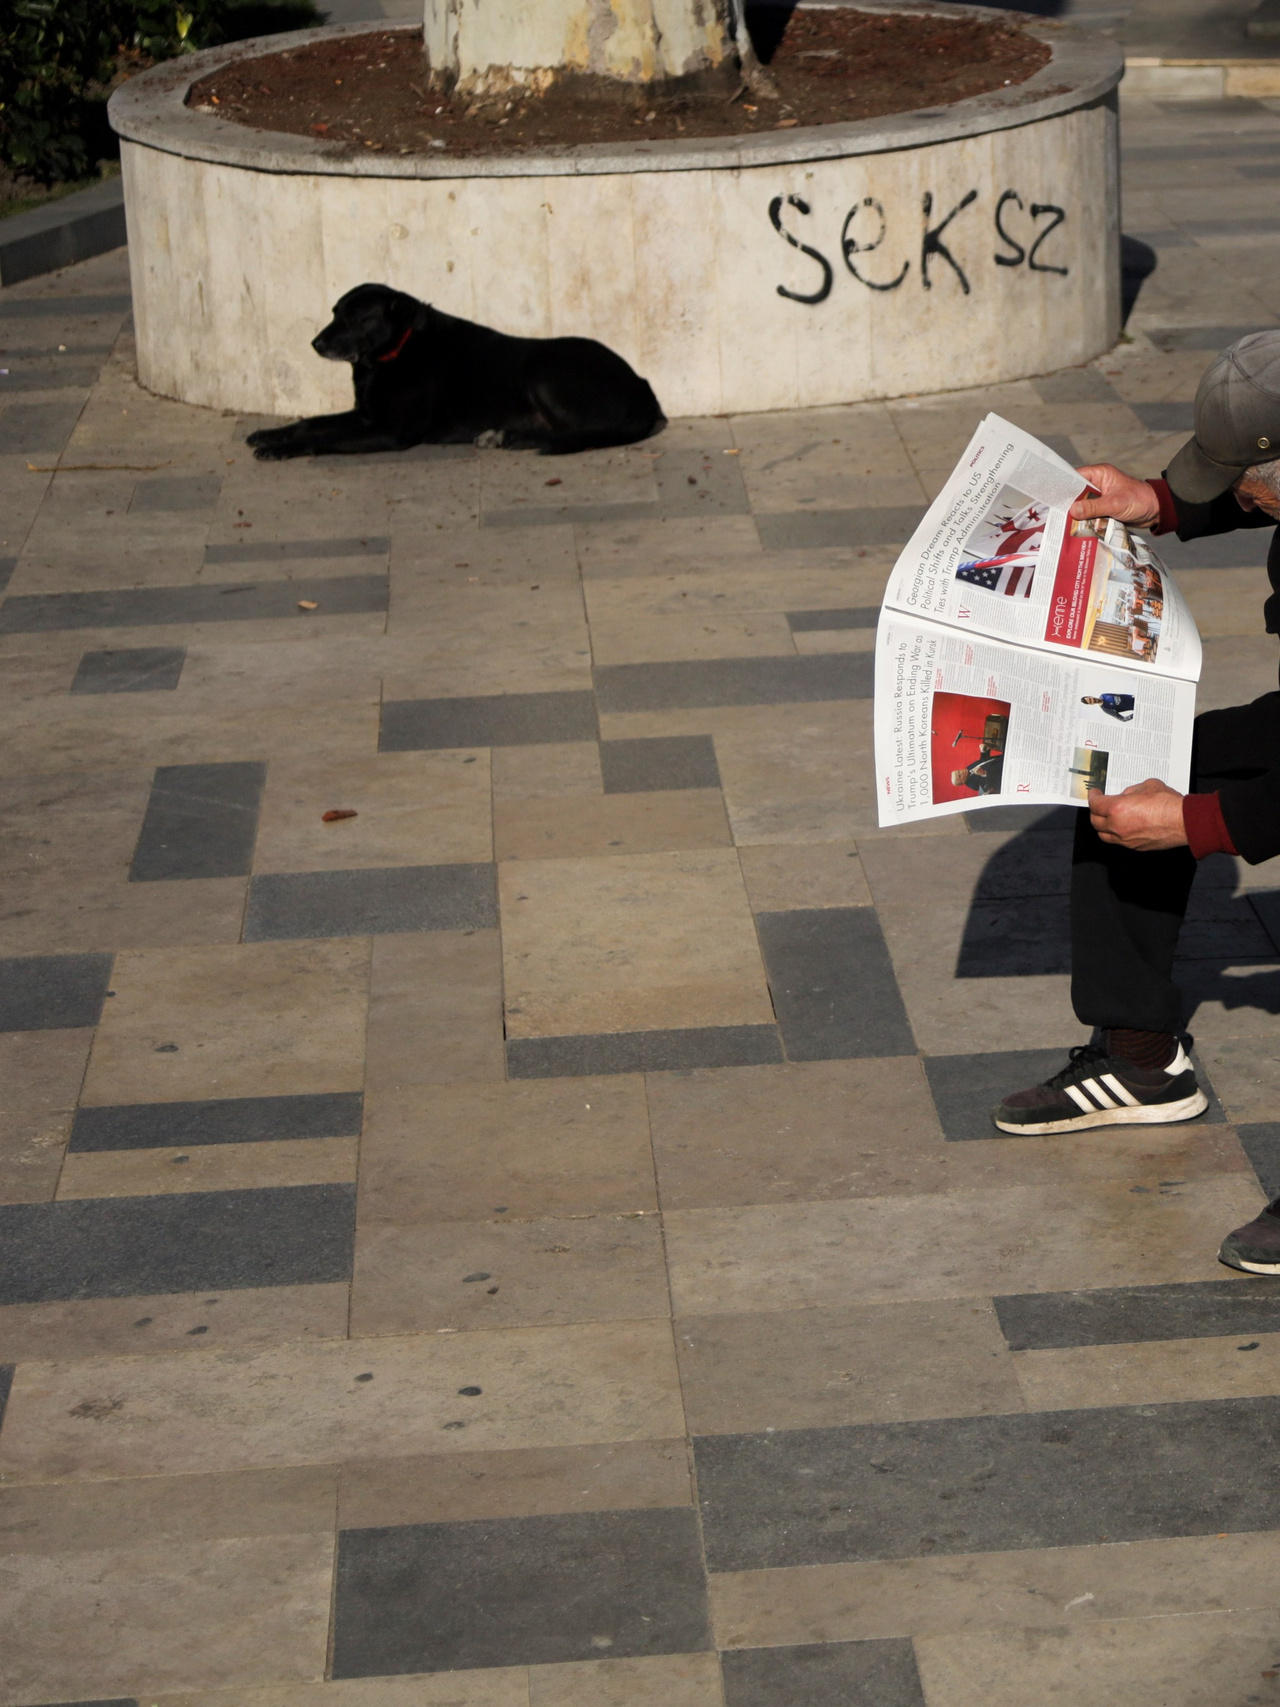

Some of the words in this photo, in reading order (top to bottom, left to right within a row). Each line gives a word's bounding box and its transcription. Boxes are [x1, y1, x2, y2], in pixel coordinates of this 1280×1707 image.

[969, 446, 985, 468] POLITICS
[920, 575, 935, 610] Political
[928, 549, 945, 575] Shifts
[942, 528, 957, 547] and
[953, 506, 973, 528] Talks
[970, 443, 1014, 504] Strengthening
[956, 482, 1001, 545] Administration
[907, 562, 926, 606] Georgian
[920, 529, 944, 561] Dream
[941, 500, 964, 527] Reacts
[962, 488, 972, 498] to
[968, 472, 982, 487] US
[941, 546, 960, 575] Trump
[940, 577, 950, 596] with
[933, 598, 947, 614] Ties
[899, 642, 907, 651] to
[910, 645, 921, 662] War
[915, 635, 923, 643] as
[925, 639, 937, 658] Kursk
[894, 653, 906, 698] Responds
[906, 664, 921, 697] Ending
[920, 669, 932, 693] Killed
[894, 701, 903, 733] Russia
[908, 700, 916, 712] on
[918, 696, 929, 737] Koreans
[894, 736, 903, 767] Latest:
[906, 715, 916, 767] Ultimatum
[918, 739, 928, 770] North
[896, 770, 905, 812] Ukraine
[907, 769, 918, 810] Trump's
[919, 773, 930, 806] 1,000
